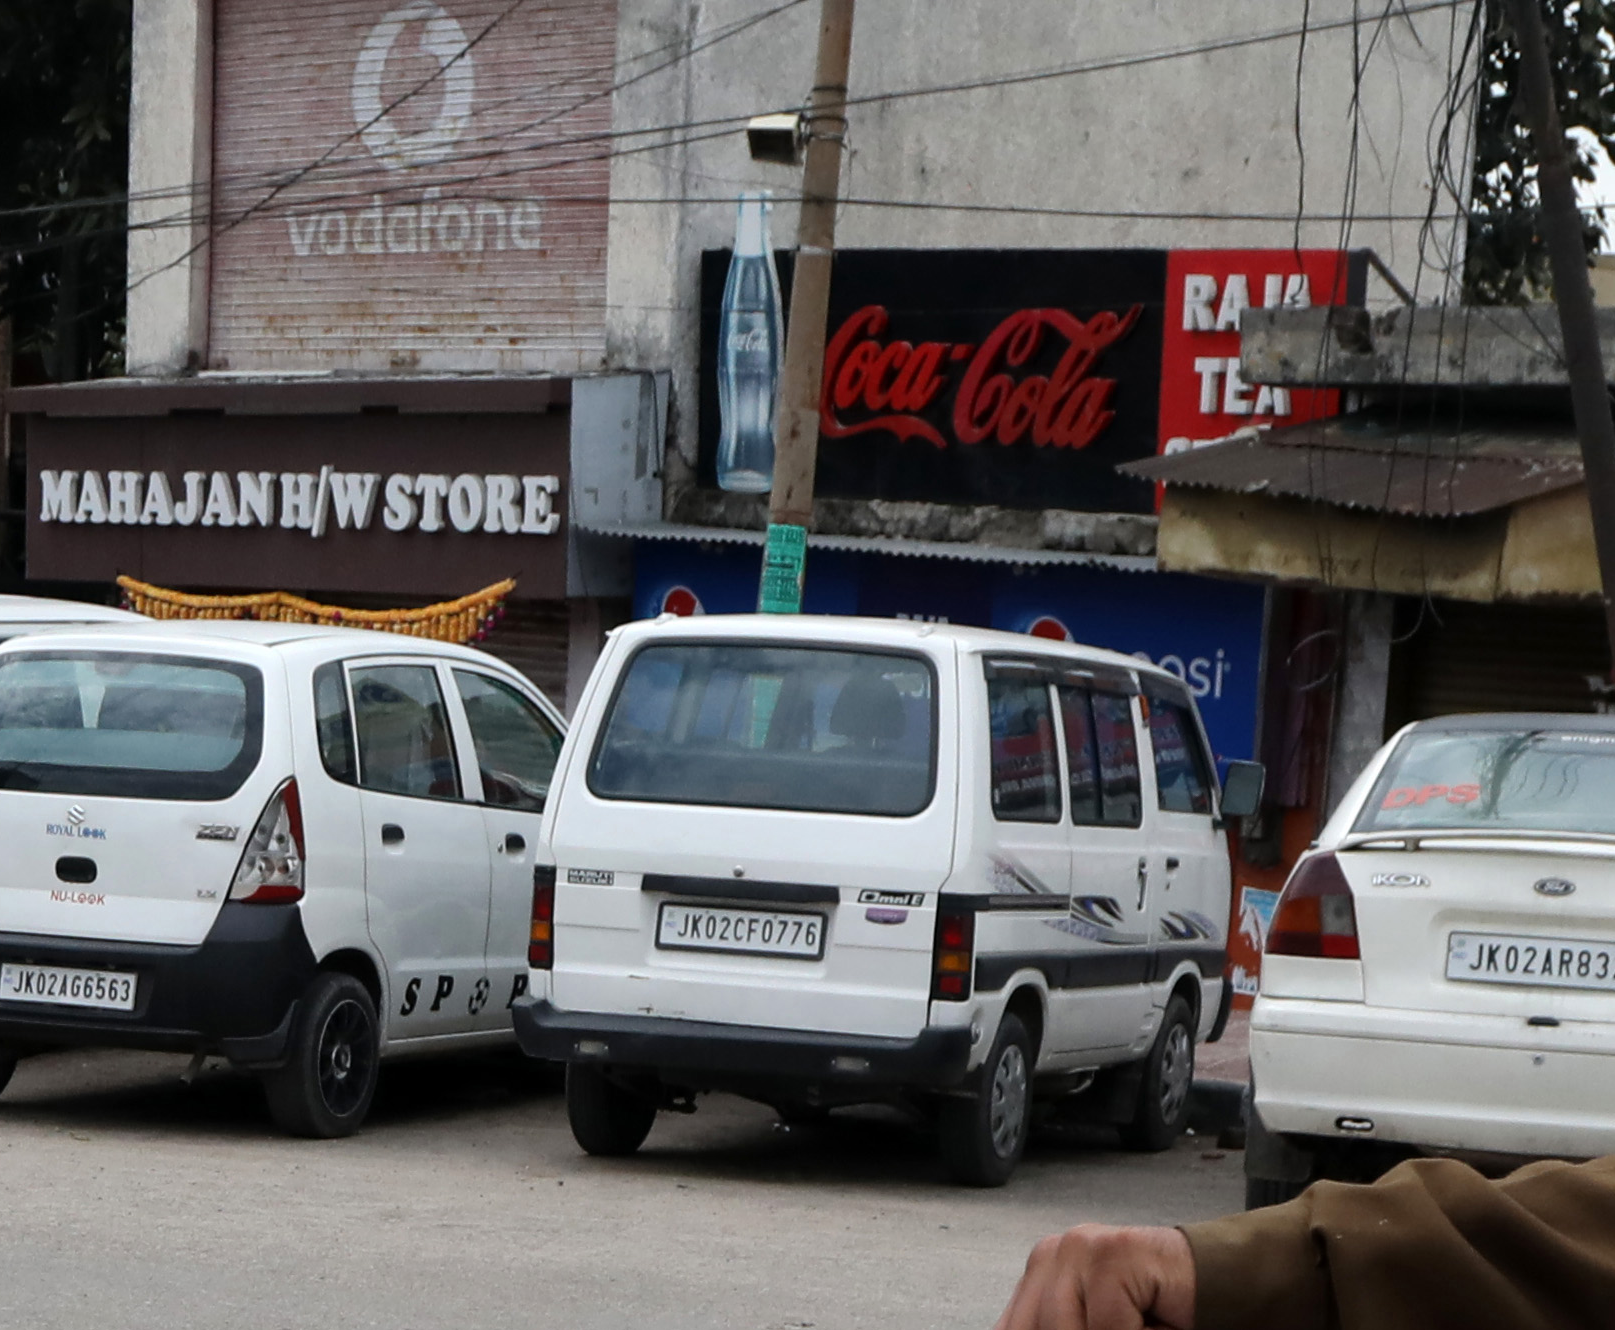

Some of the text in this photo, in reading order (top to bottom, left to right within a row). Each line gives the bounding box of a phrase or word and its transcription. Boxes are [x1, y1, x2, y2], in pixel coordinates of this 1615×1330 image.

[287, 185, 542, 257] vodafone
[820, 303, 1146, 450] Coca-Cola
[40, 464, 561, 538] MAHAJAN H/W STORE
[1381, 783, 1481, 810] DPS
[46, 823, 107, 841] ROYAL LOOK
[50, 889, 106, 906] NU-LOOK
[677, 911, 817, 947] JK02CF0776
[12, 971, 132, 1003] JK02AG6563
